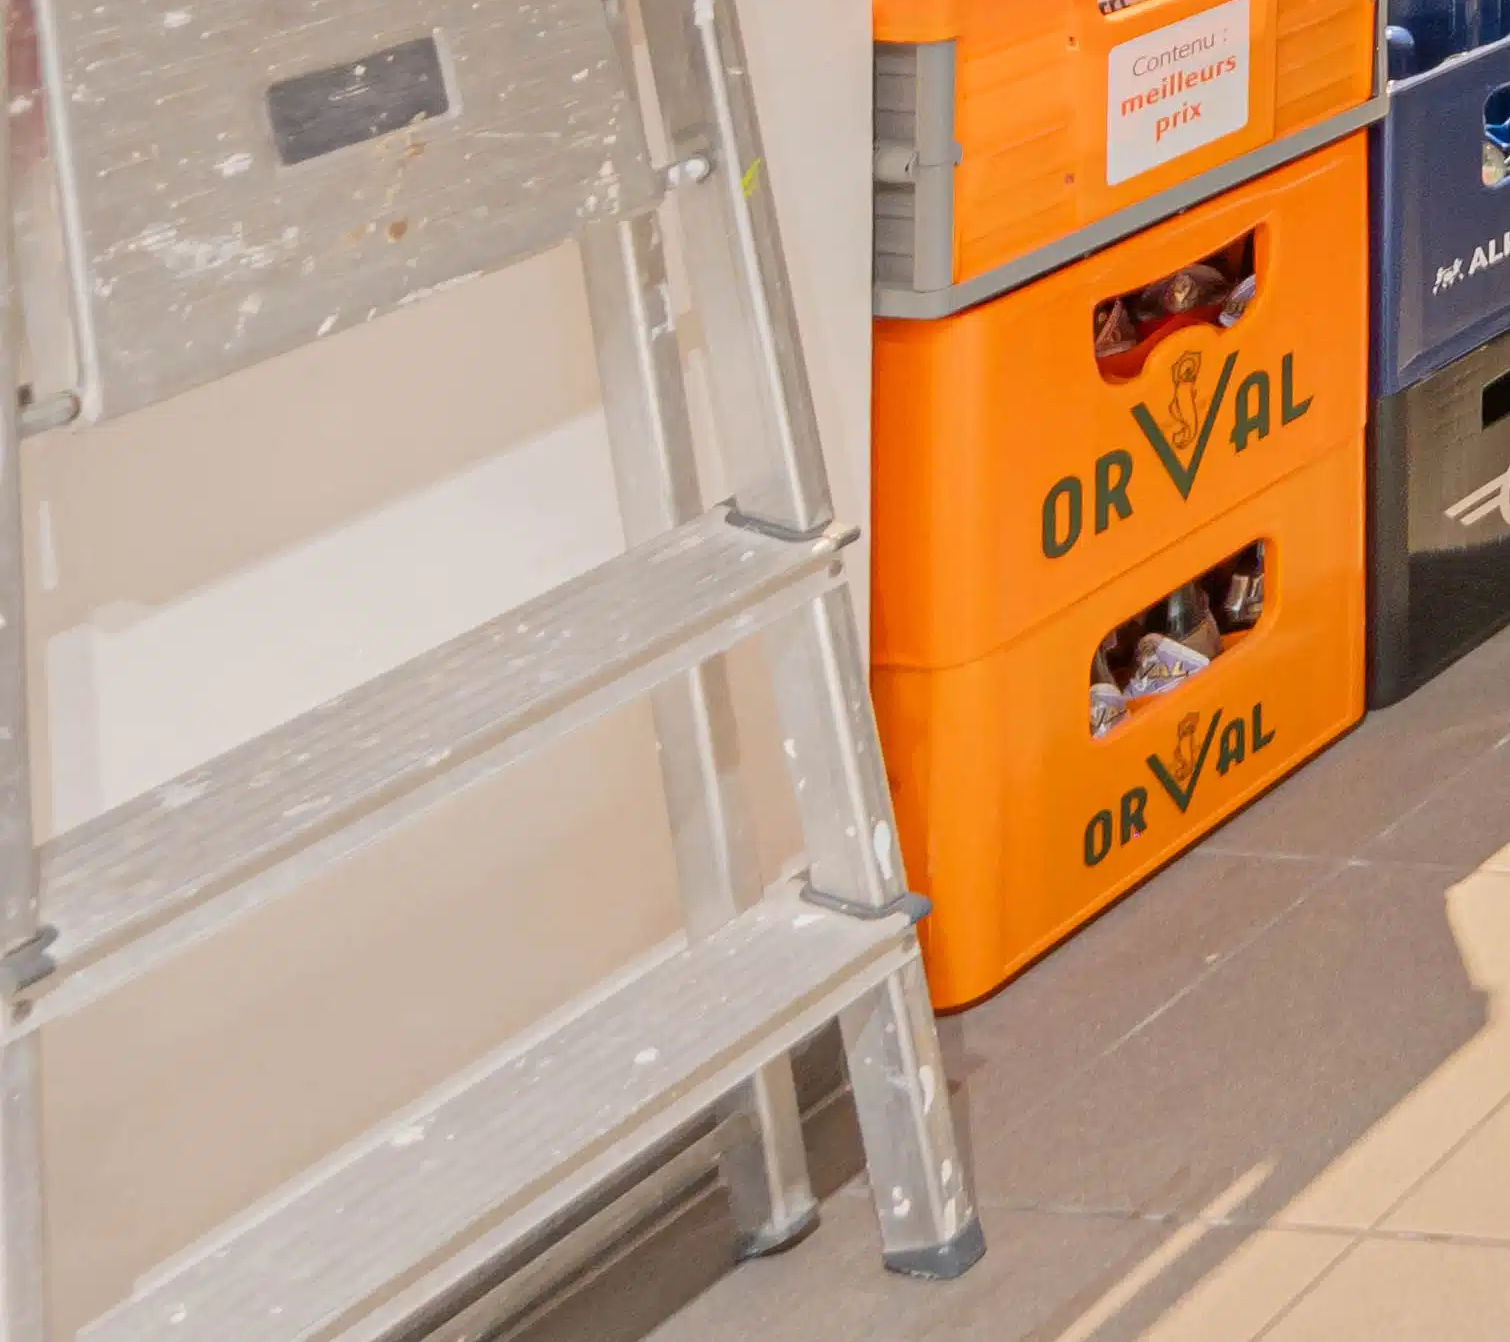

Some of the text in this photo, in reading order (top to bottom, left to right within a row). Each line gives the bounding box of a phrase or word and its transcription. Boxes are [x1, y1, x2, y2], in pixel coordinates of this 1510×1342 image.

[1132, 32, 1216, 77] Contenu
[1120, 55, 1238, 117] meilleurs
[1155, 101, 1203, 142] prix
[1042, 349, 1315, 559] ORVAL
[1084, 701, 1277, 867] ORVAL
